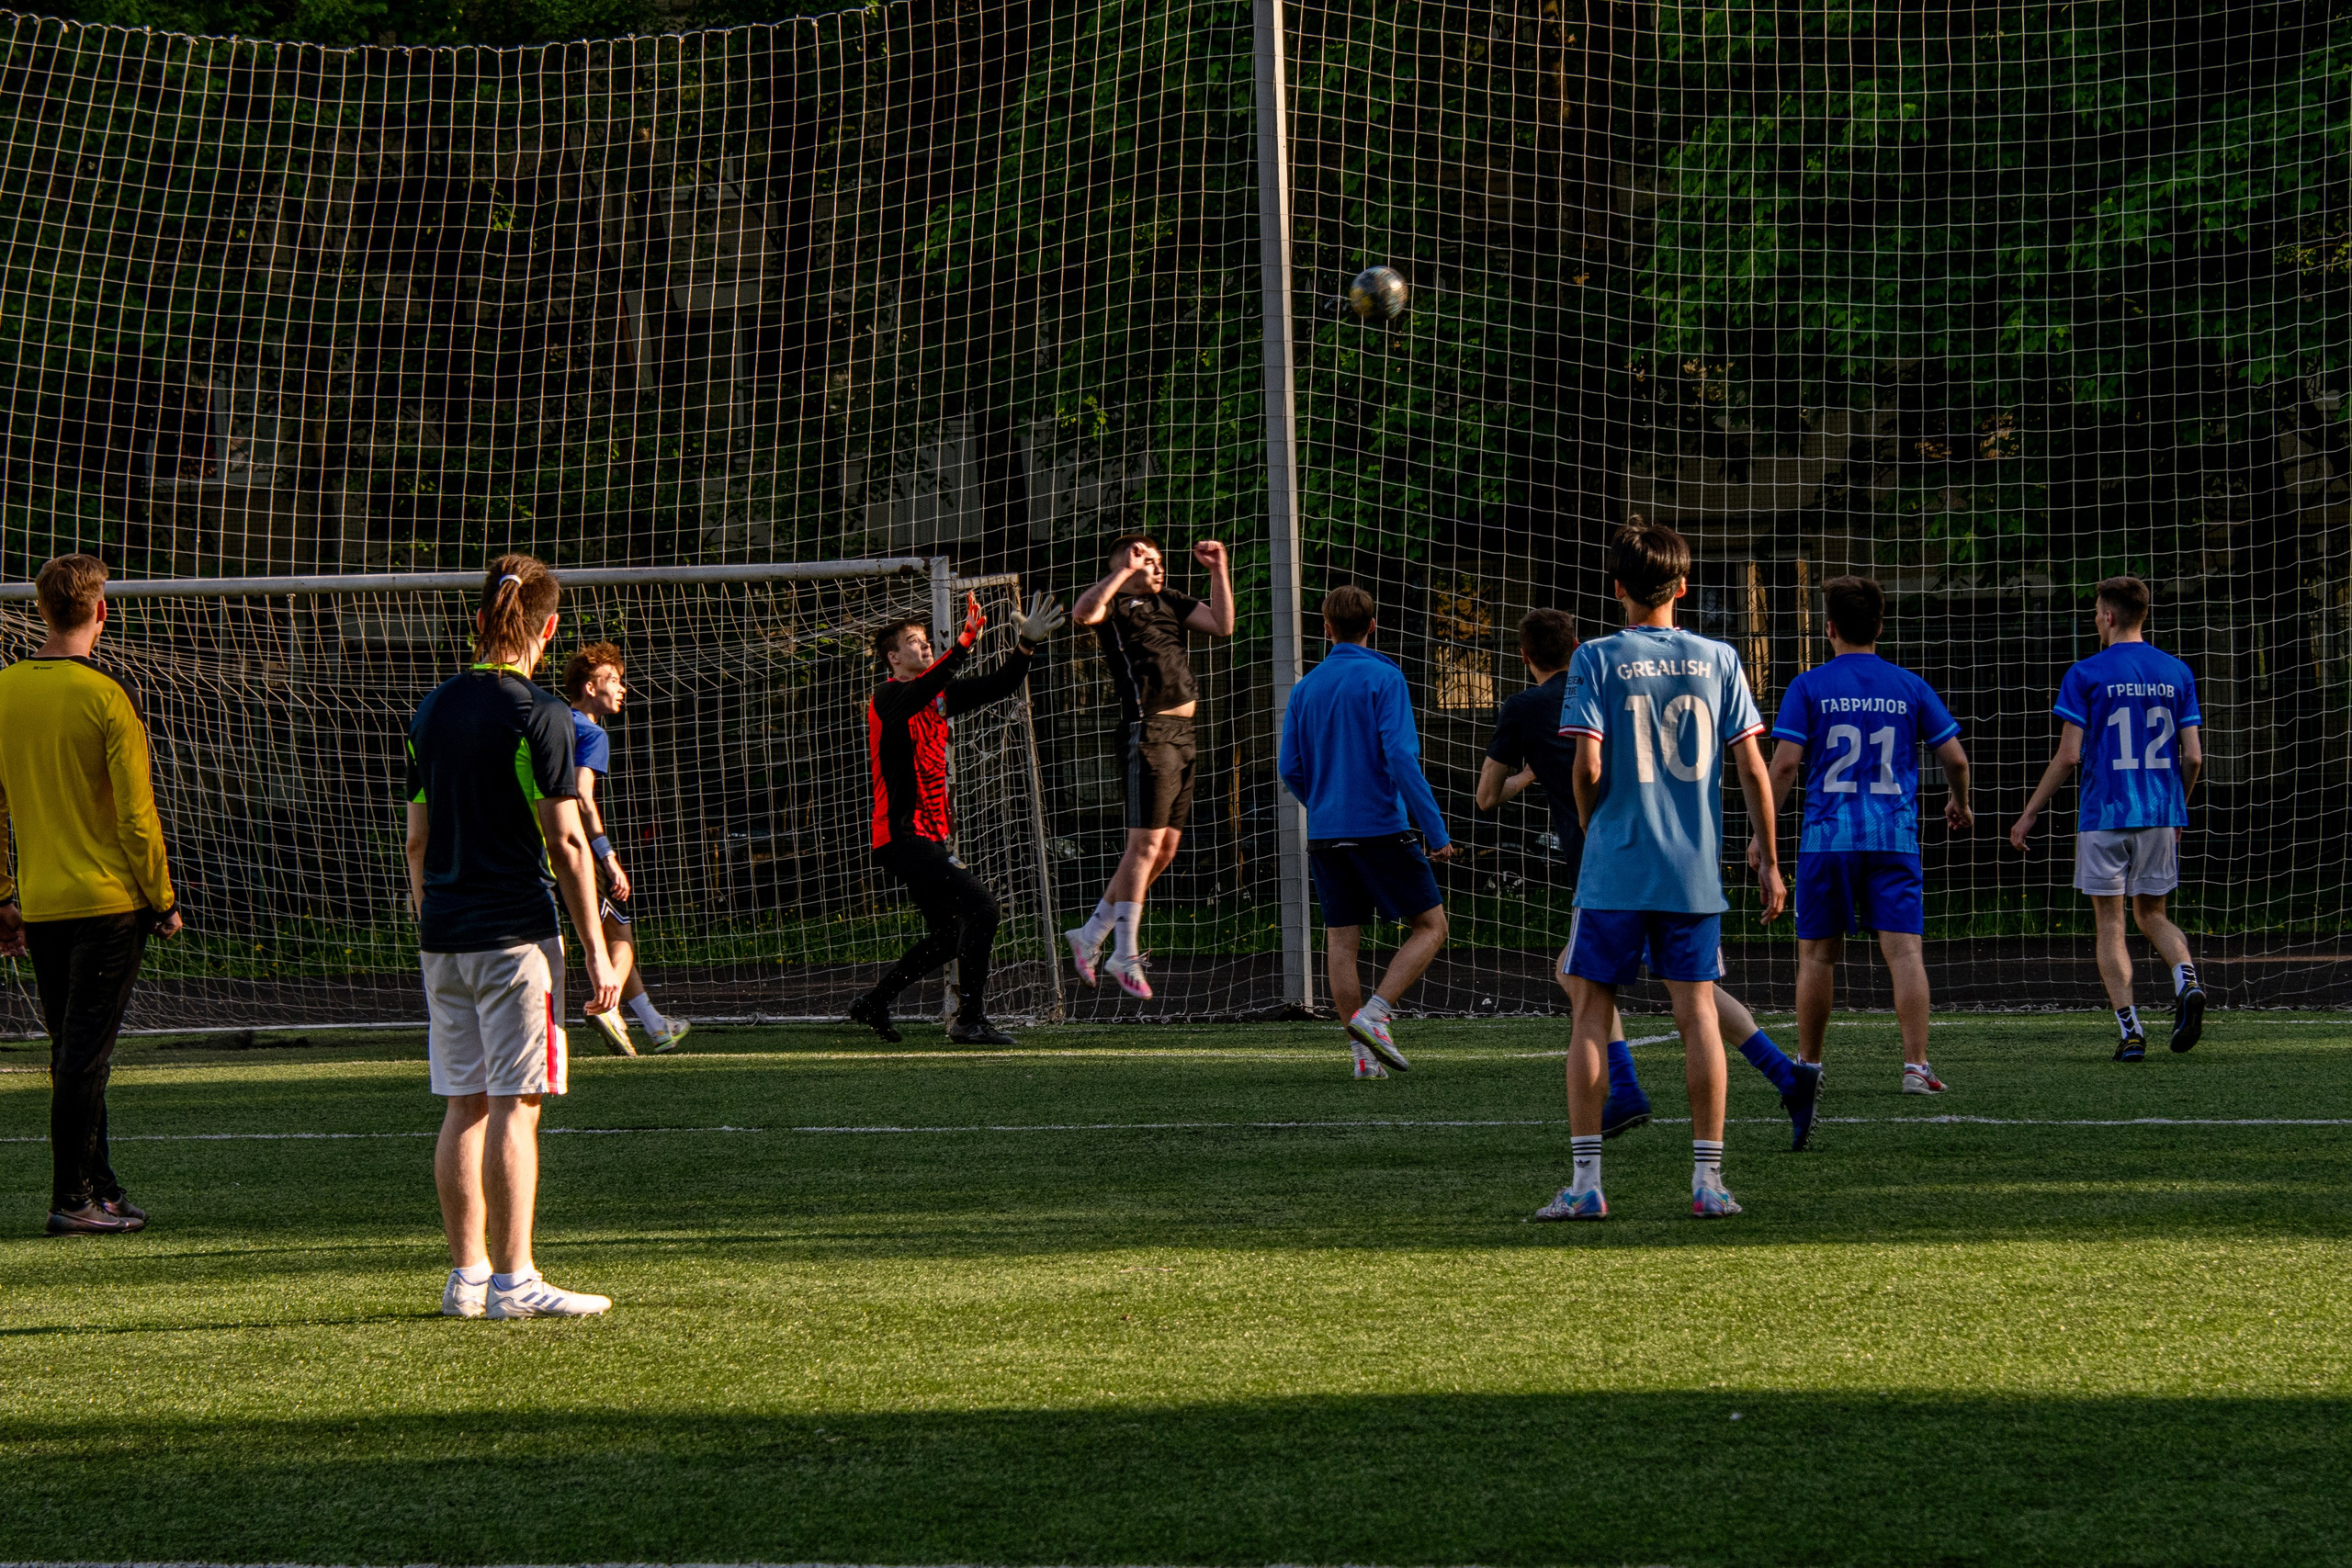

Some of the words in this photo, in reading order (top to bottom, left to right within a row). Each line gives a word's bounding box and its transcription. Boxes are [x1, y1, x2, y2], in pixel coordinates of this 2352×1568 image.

[1617, 660, 1712, 680] GREALISH
[2107, 682, 2175, 698] ГРЕШНОВ
[1821, 697, 1907, 715] ГАВРИЛОВ
[1624, 694, 1713, 784] 10
[2107, 705, 2175, 770] 12
[1823, 724, 1903, 795] 21
